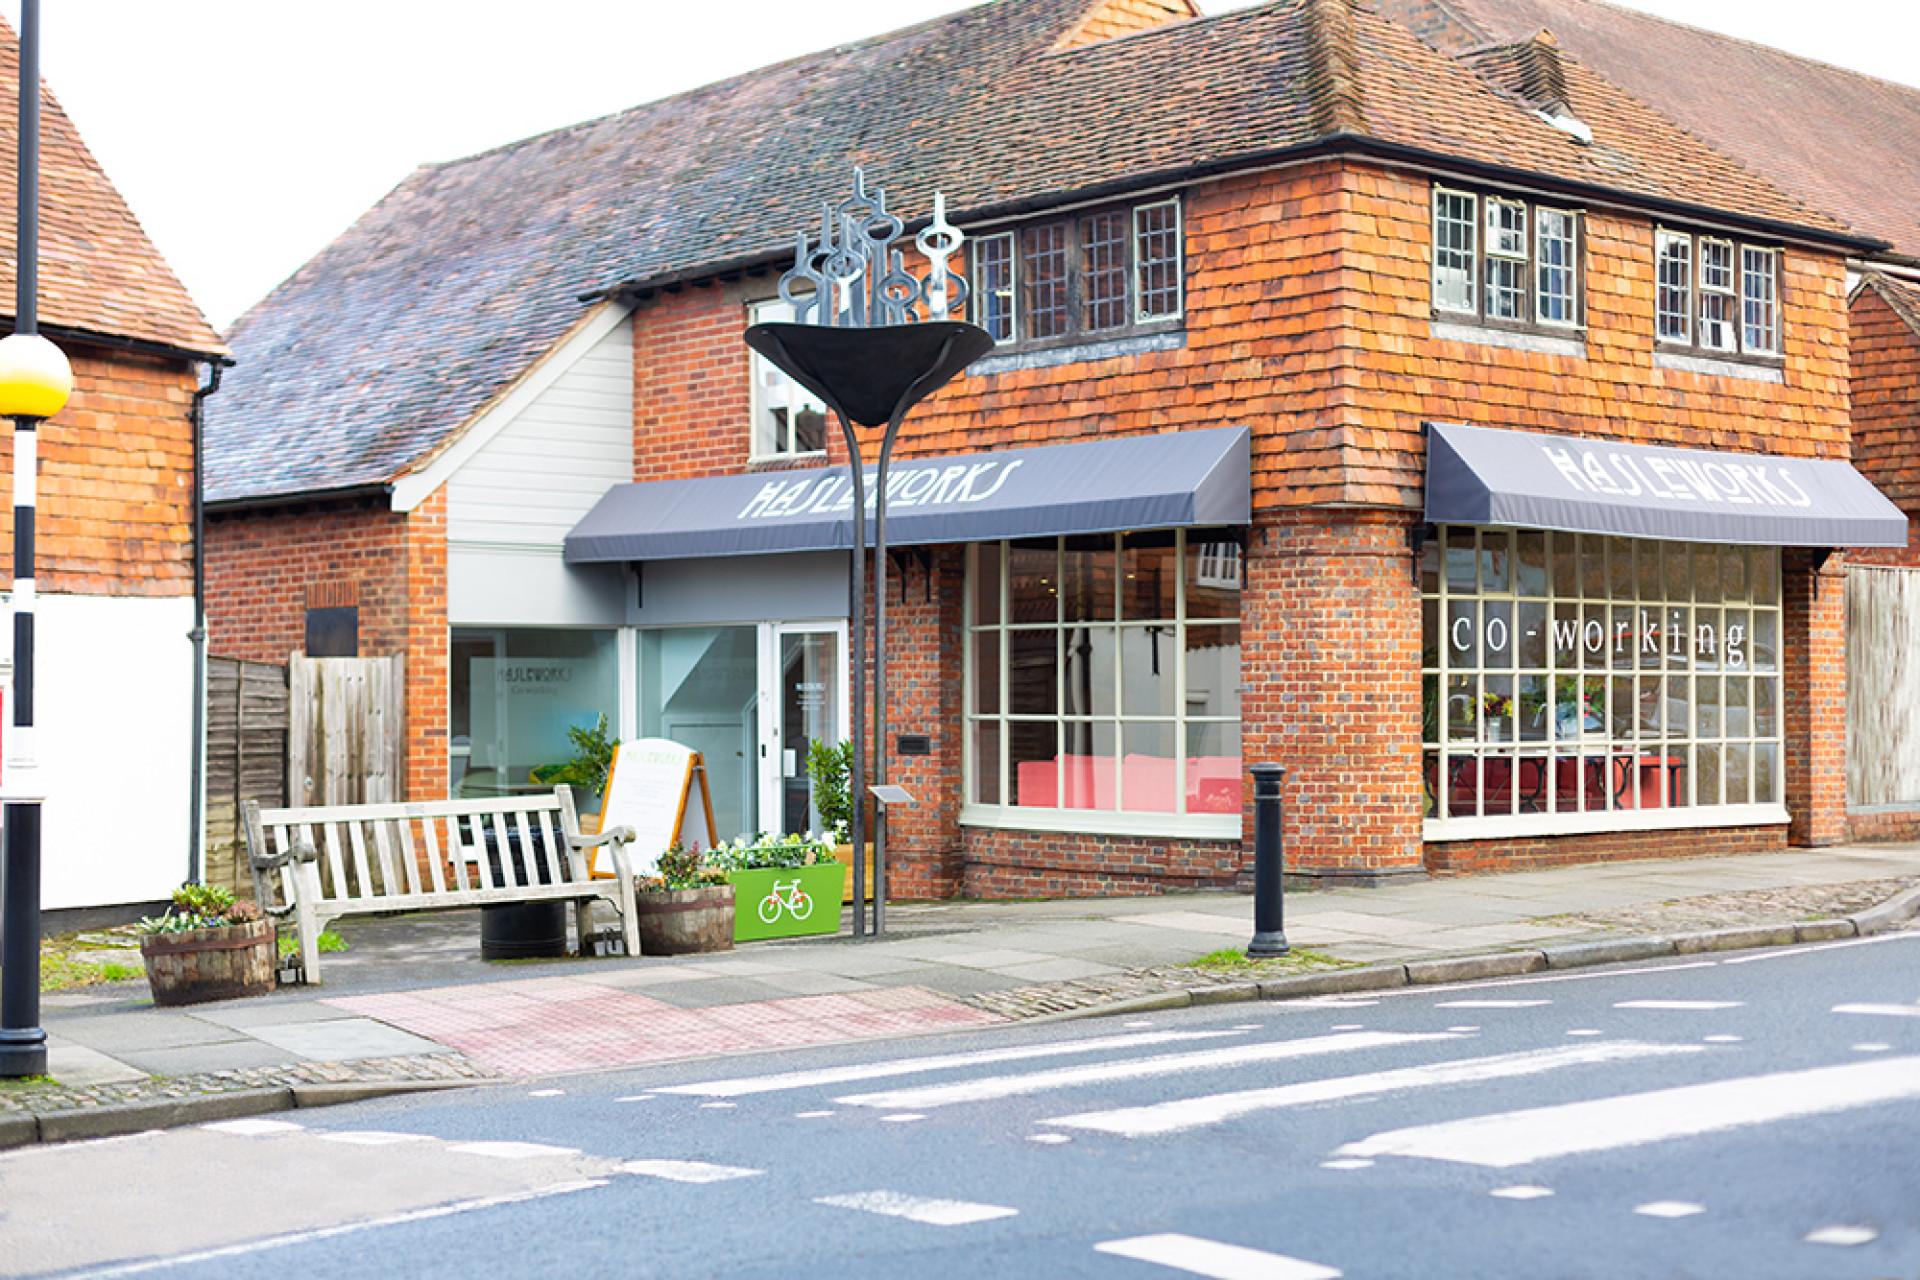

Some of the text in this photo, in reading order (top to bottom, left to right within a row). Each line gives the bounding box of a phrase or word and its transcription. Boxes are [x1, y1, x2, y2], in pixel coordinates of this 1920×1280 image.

[737, 459, 1024, 519] HASLEWORKS
[1542, 446, 1811, 507] HASLEWORKS
[1452, 610, 1745, 666] co-working
